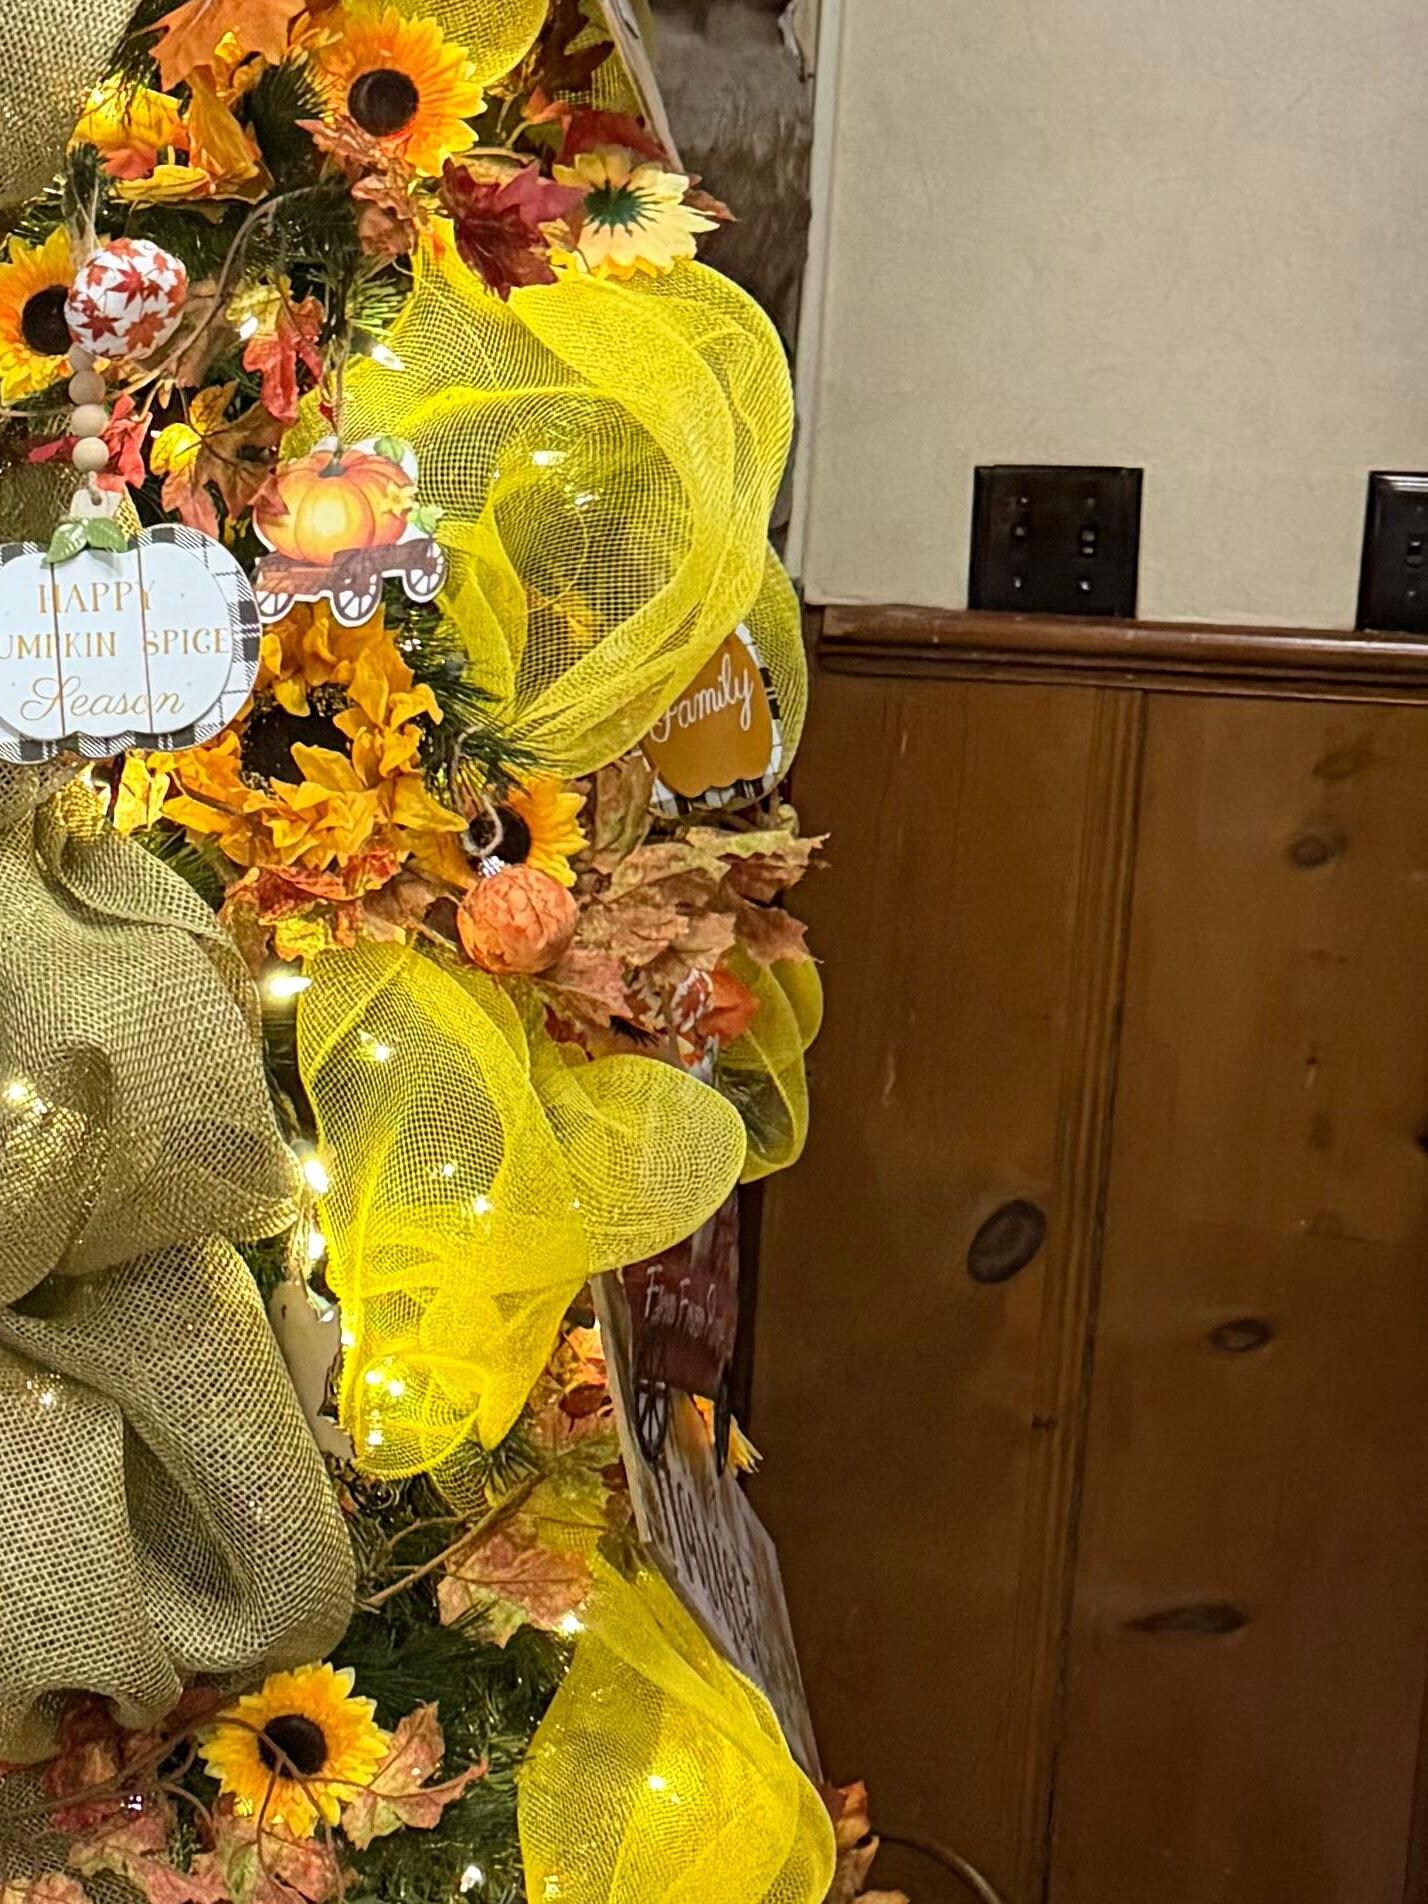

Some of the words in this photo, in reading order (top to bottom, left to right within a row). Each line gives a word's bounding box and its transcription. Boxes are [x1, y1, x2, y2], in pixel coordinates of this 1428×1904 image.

[37, 580, 156, 614] HAPPY
[142, 627, 231, 657] SPICE
[19, 676, 186, 722] Season
